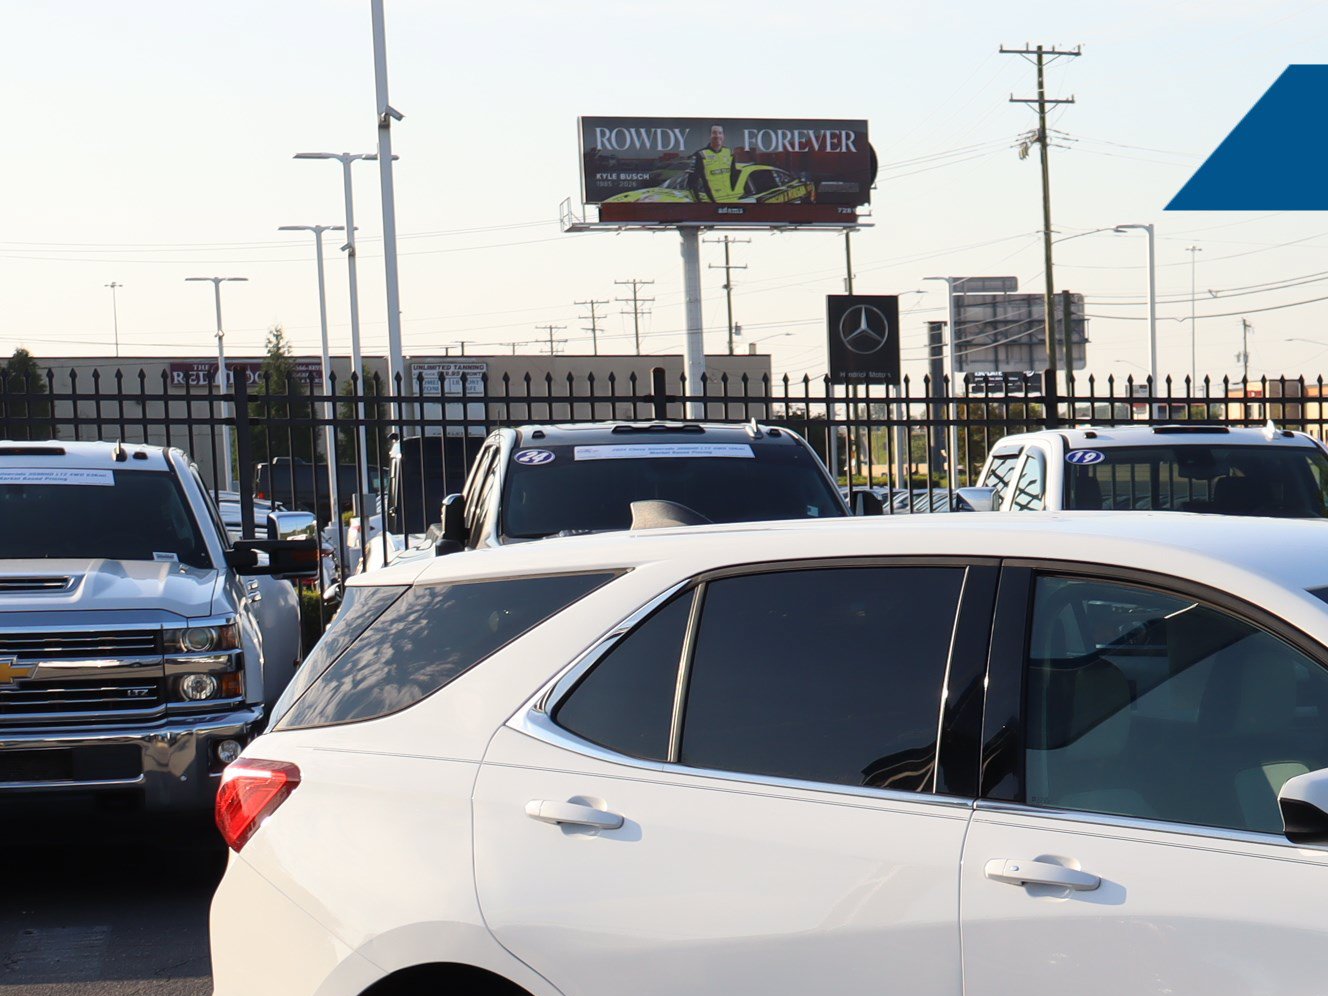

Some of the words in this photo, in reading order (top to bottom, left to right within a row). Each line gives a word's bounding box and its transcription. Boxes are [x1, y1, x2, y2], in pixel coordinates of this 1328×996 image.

[595, 127, 690, 150] ROWDY
[743, 129, 857, 152] FOREVER
[525, 451, 546, 463] 24
[1073, 451, 1096, 463] 19
